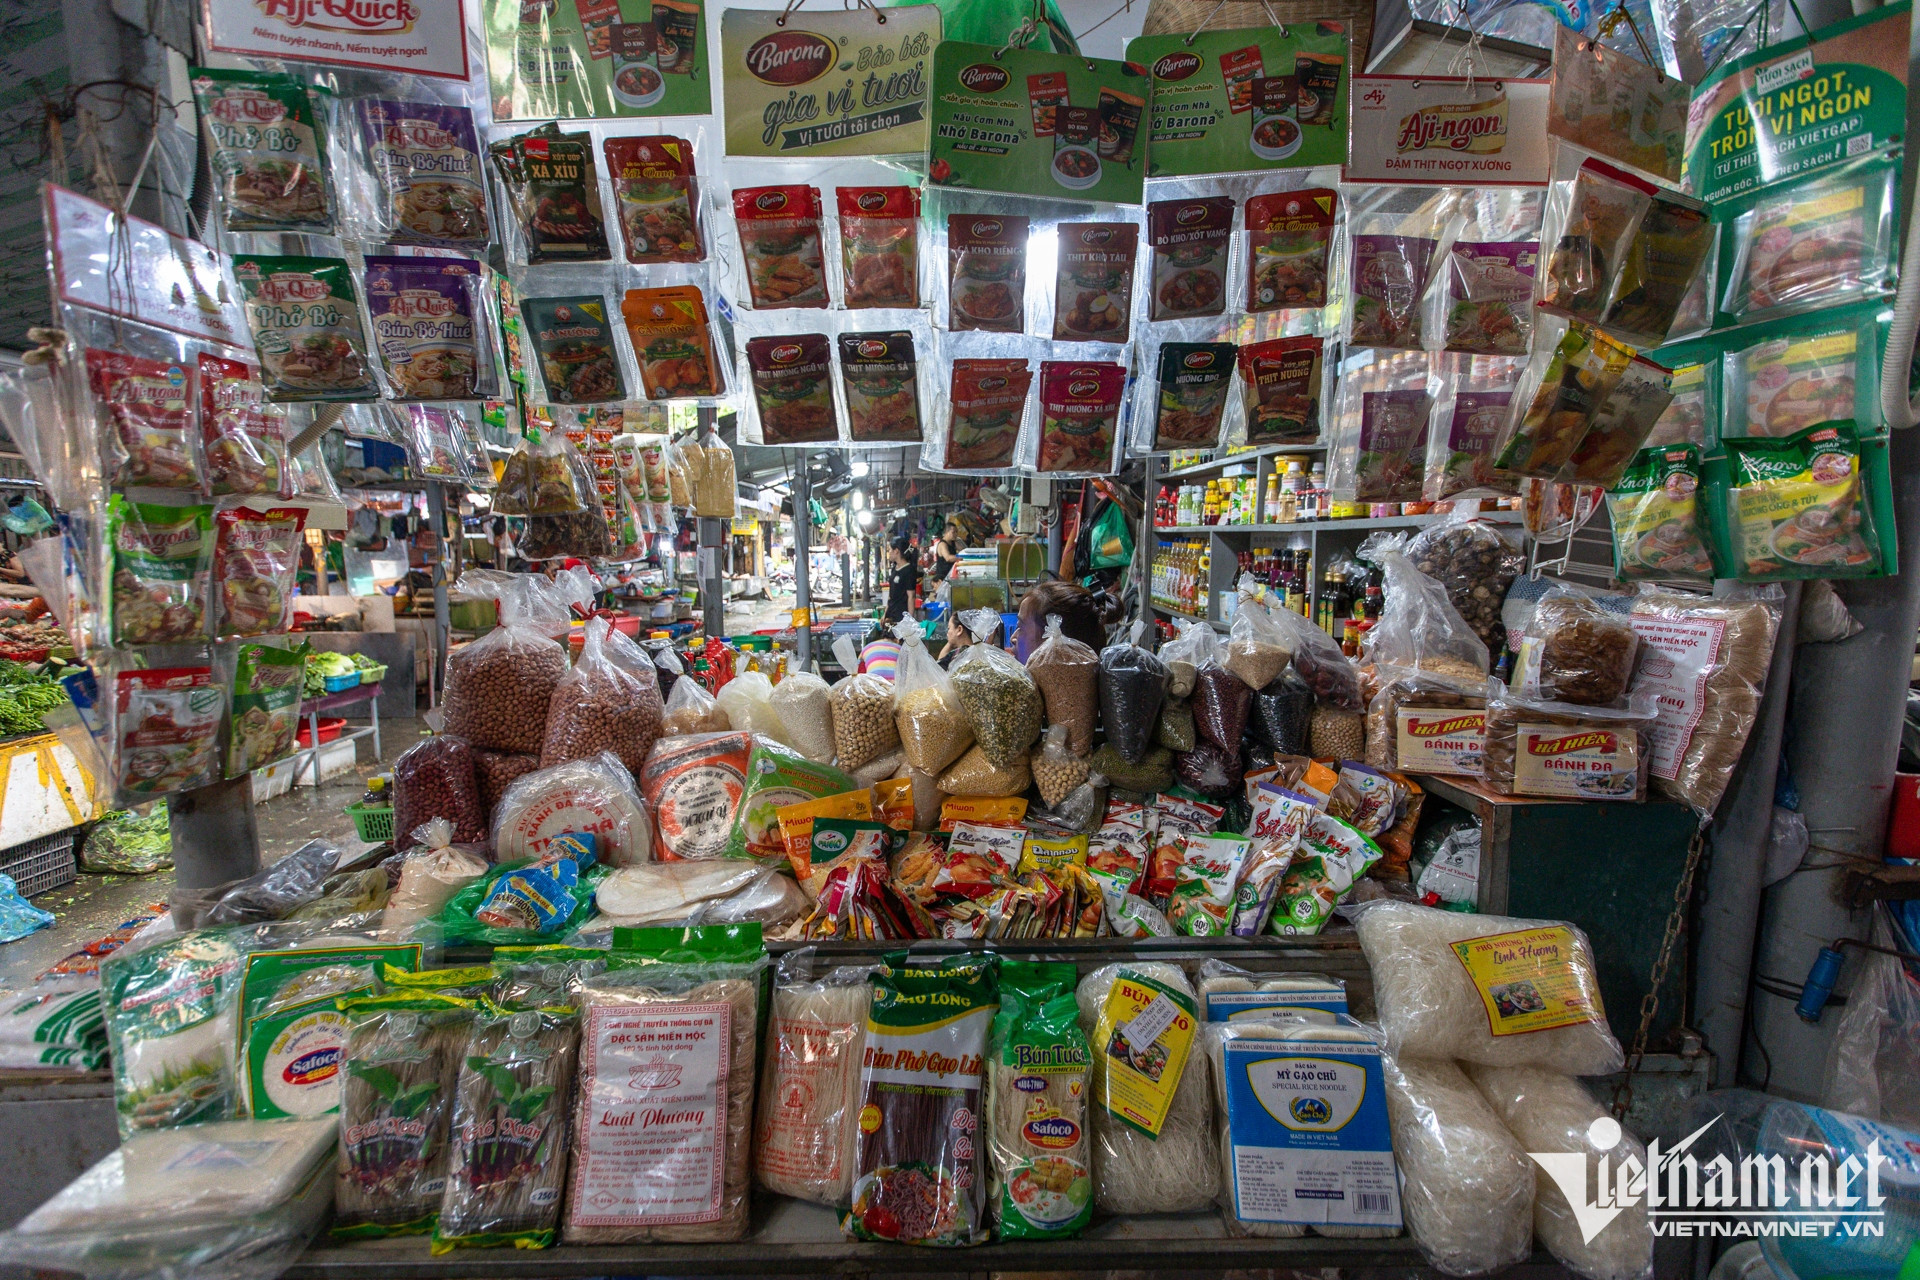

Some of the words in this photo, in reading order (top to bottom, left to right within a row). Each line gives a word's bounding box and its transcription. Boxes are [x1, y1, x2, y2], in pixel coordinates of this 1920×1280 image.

[279, 34, 307, 46] tuyệt
[309, 40, 345, 52] nhanh,
[347, 43, 371, 54] Nếm
[372, 46, 398, 58] tuyệt
[400, 46, 428, 57] ngon!
[856, 45, 895, 72] Bảo
[898, 32, 930, 62] bối
[750, 42, 826, 73] Barona
[1154, 56, 1199, 77] Barona
[961, 66, 1006, 86] Barona
[1780, 70, 1854, 111] NGỌT,
[761, 89, 820, 146] gia
[827, 79, 856, 122] vị
[862, 60, 926, 107] tươi
[1169, 102, 1189, 113] Cơm
[1192, 100, 1210, 110] Nhà
[1770, 115, 1793, 136] VỊ
[1800, 85, 1872, 127] NGON
[952, 111, 971, 123] Nấu
[974, 115, 994, 126] Cơm
[996, 116, 1015, 128] Nhà
[1166, 114, 1216, 130] Barona
[800, 130, 813, 147] Vị
[815, 122, 847, 141] TƯƠI
[850, 116, 868, 133] tôi
[871, 113, 901, 132] chọn
[938, 124, 967, 140] Nhớ
[970, 127, 1020, 145] Barona
[1397, 111, 1503, 150] Aji-ngon
[1799, 117, 1860, 147] VIETGAP
[264, 126, 300, 152] Bò
[531, 161, 551, 179] XÁ
[553, 161, 578, 179] XÍU
[1386, 156, 1412, 170] ĐẬM
[1413, 158, 1437, 171] THỊT
[1439, 160, 1469, 172] NGỌT
[1471, 159, 1512, 171] XƯƠNG
[758, 194, 785, 208] Barona
[859, 194, 885, 208] Barona
[1178, 207, 1204, 222] Barona
[974, 222, 1001, 235] Barona
[1084, 230, 1111, 242] Barona
[1157, 234, 1169, 245] BÒ
[1206, 227, 1227, 239] VANG
[971, 246, 992, 256] KHO
[1066, 252, 1087, 263] THỊT
[1088, 252, 1108, 263] KHO
[1109, 252, 1127, 263] TÀU
[255, 304, 306, 328] Phở
[308, 304, 343, 328] Bò
[378, 320, 413, 338] Bún
[414, 321, 438, 340] Bò
[438, 318, 473, 339] Huế
[561, 325, 600, 338] NƯỚNG
[772, 345, 800, 359] Barona
[860, 343, 884, 356] Barona
[1185, 353, 1213, 366] Barona
[1258, 372, 1277, 386] THỊT
[1280, 366, 1310, 381] NƯỚNG
[1070, 382, 1098, 395] Barona
[1066, 403, 1093, 414] NƯỚNG
[1649, 634, 1662, 643] SẢN
[1663, 635, 1680, 645] MIẾN
[1681, 638, 1699, 648] MỘC
[1414, 720, 1445, 736] HÀ
[1424, 739, 1463, 751] BÁNH
[1534, 739, 1561, 753] HÀ
[1544, 756, 1586, 771] BÁNH
[1591, 761, 1613, 772] ĐA
[555, 799, 573, 811] ĐA
[945, 802, 975, 813] Miwon
[1475, 941, 1493, 953] PHỞ
[1493, 948, 1516, 966] Linh
[930, 992, 972, 1007] LONG
[642, 1018, 669, 1029] TRUYỀN
[670, 1017, 692, 1028] THỐNG
[611, 1033, 632, 1044] ĐẶC
[634, 1031, 655, 1043] SẢN
[657, 1030, 683, 1042] MIẾN
[685, 1030, 706, 1042] MỘC
[661, 1043, 674, 1052] bột
[675, 1043, 693, 1053] dong
[290, 1050, 343, 1075] Safoco
[863, 1046, 894, 1069] Bún
[894, 1049, 928, 1072] Phở
[927, 1052, 958, 1079] Gạo
[1012, 1043, 1051, 1070] Bún
[1277, 1069, 1291, 1081] MỲ
[1294, 1070, 1314, 1083] GẠO
[1316, 1069, 1337, 1081] CHŨ
[1272, 1082, 1300, 1090] SPECIAL
[1301, 1083, 1318, 1091] RICE
[1319, 1083, 1347, 1092] NOODLE
[598, 1108, 635, 1130] Luật
[640, 1107, 706, 1130] Phương
[345, 1118, 378, 1145] Gió
[382, 1116, 426, 1138] Xuân
[461, 1119, 495, 1144] Gió
[500, 1117, 543, 1140] Xuân
[1032, 1122, 1072, 1136] Safoco
[1290, 1133, 1305, 1141] MADE
[1326, 1134, 1338, 1142] NAM
